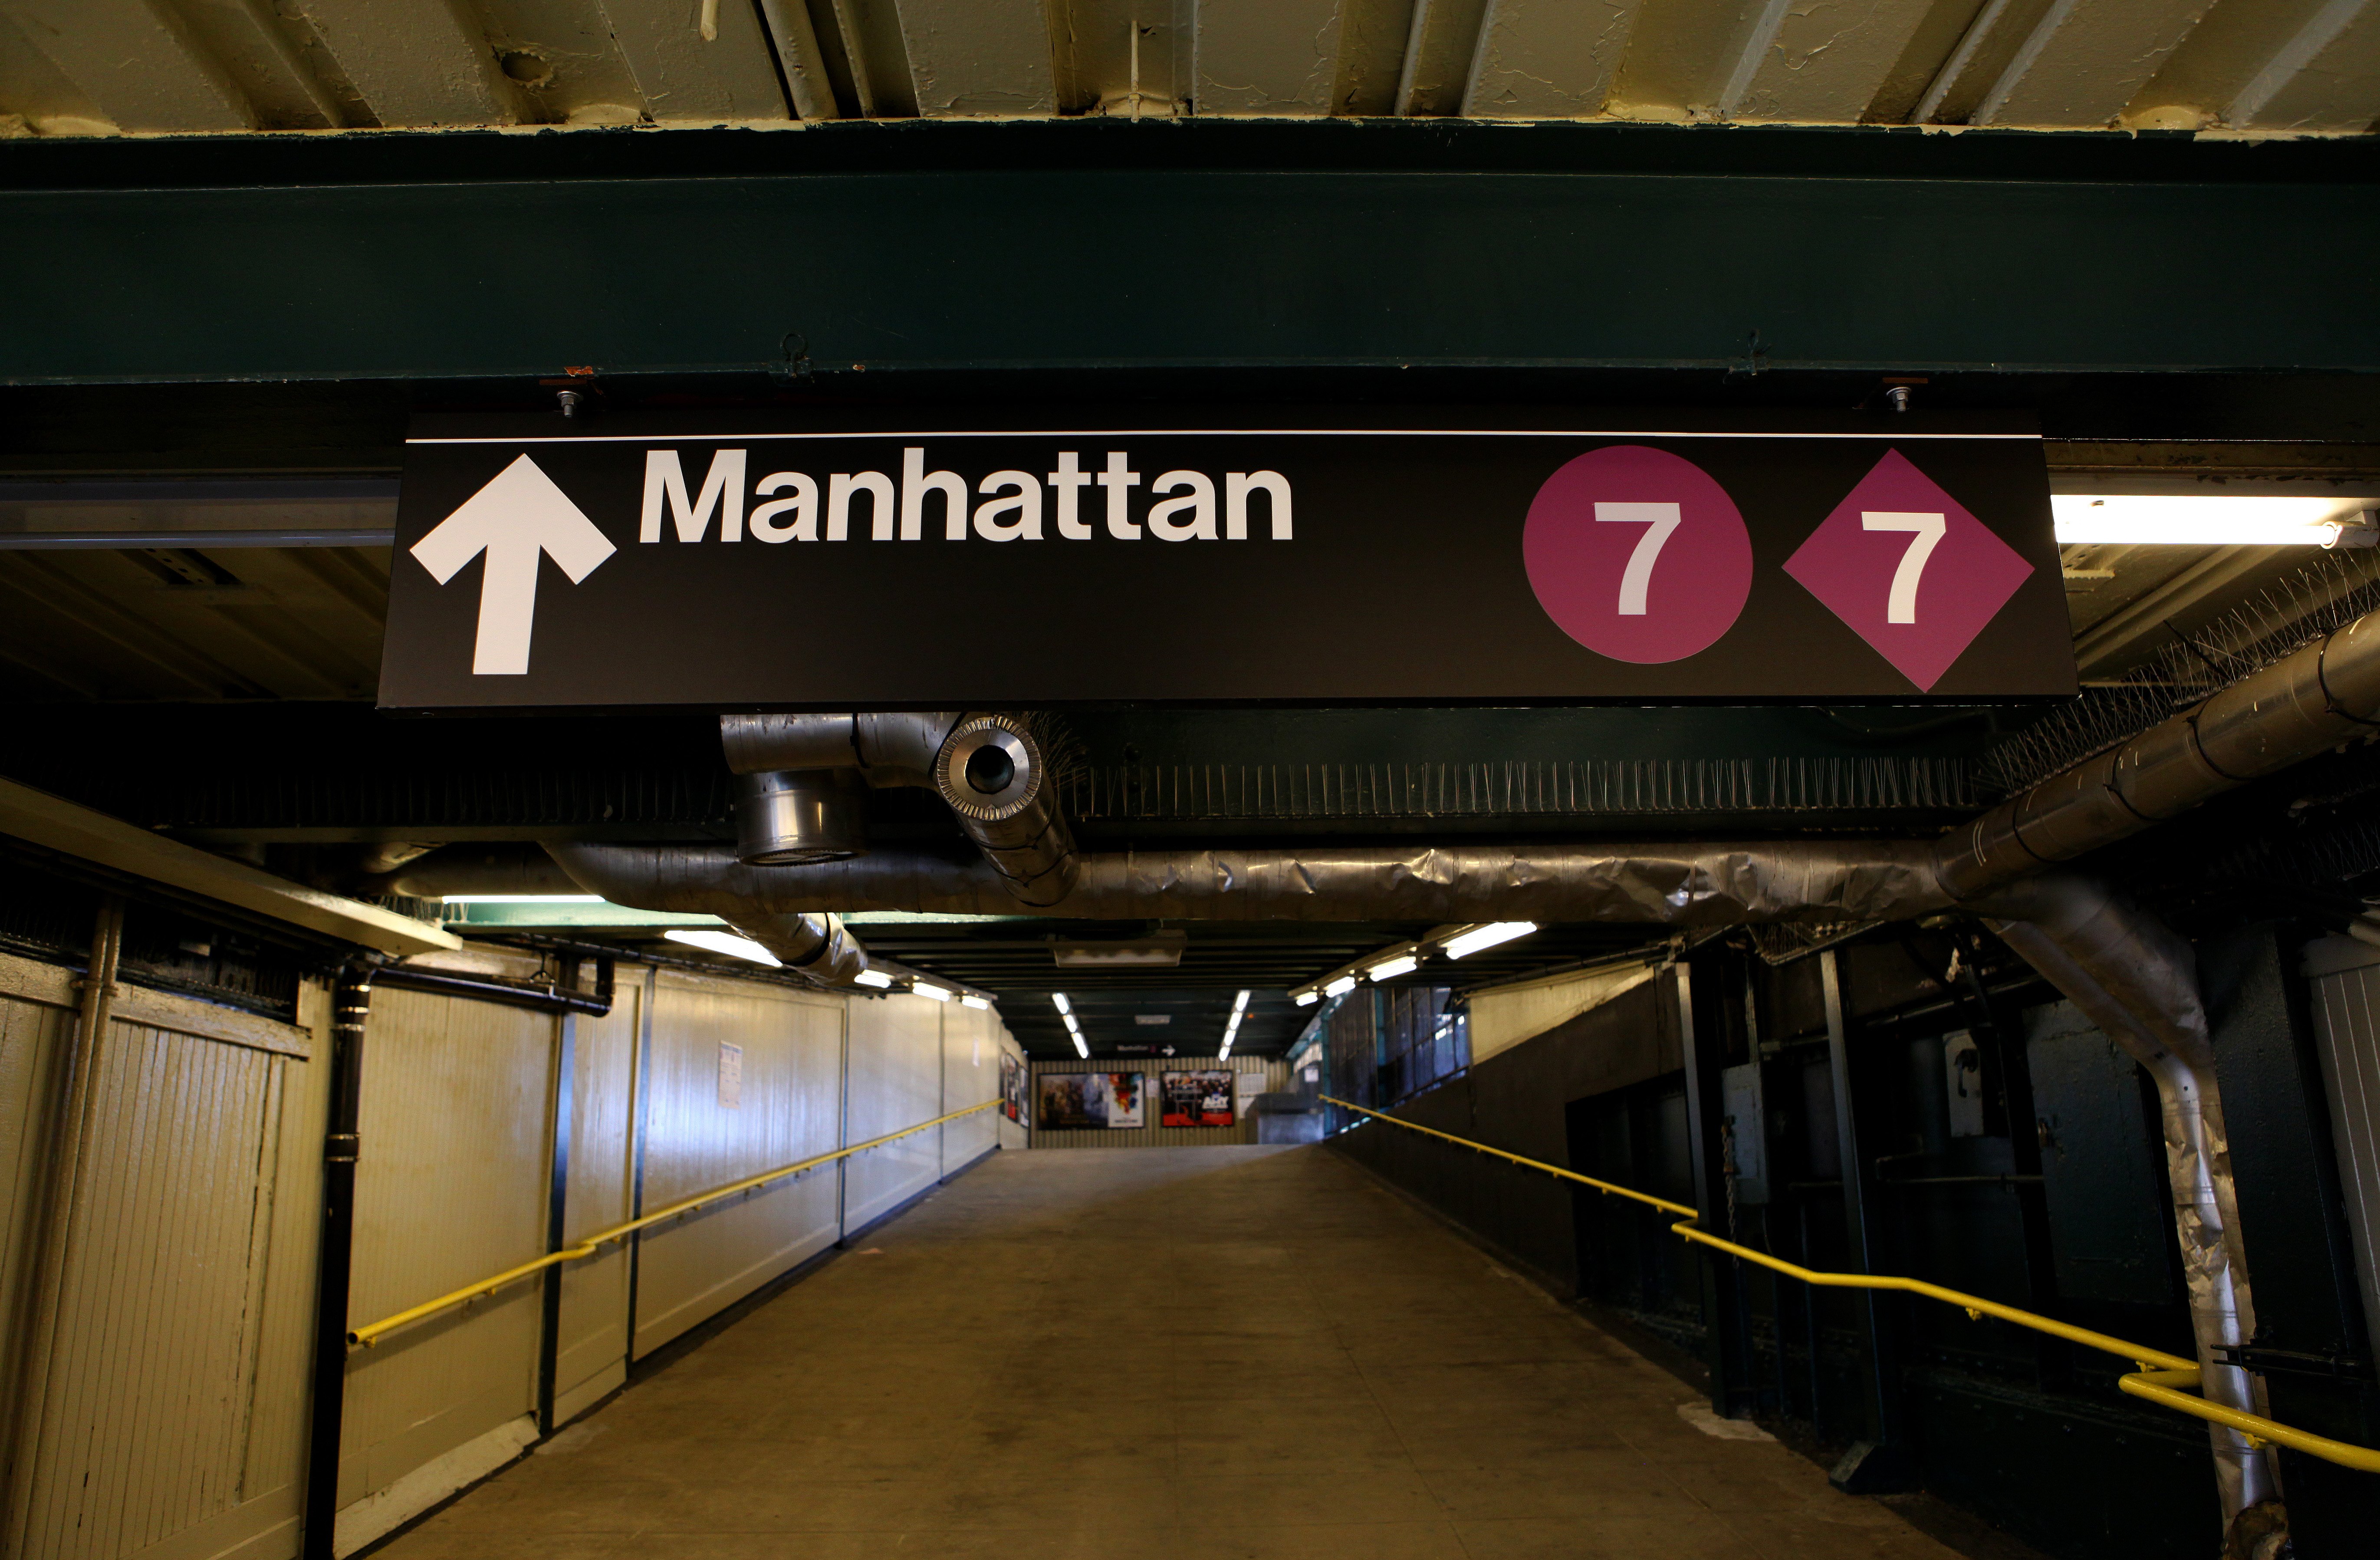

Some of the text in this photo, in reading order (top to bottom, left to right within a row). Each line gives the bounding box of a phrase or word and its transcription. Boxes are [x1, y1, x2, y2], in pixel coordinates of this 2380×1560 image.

[639, 448, 1946, 624] Manhattan 7 7
